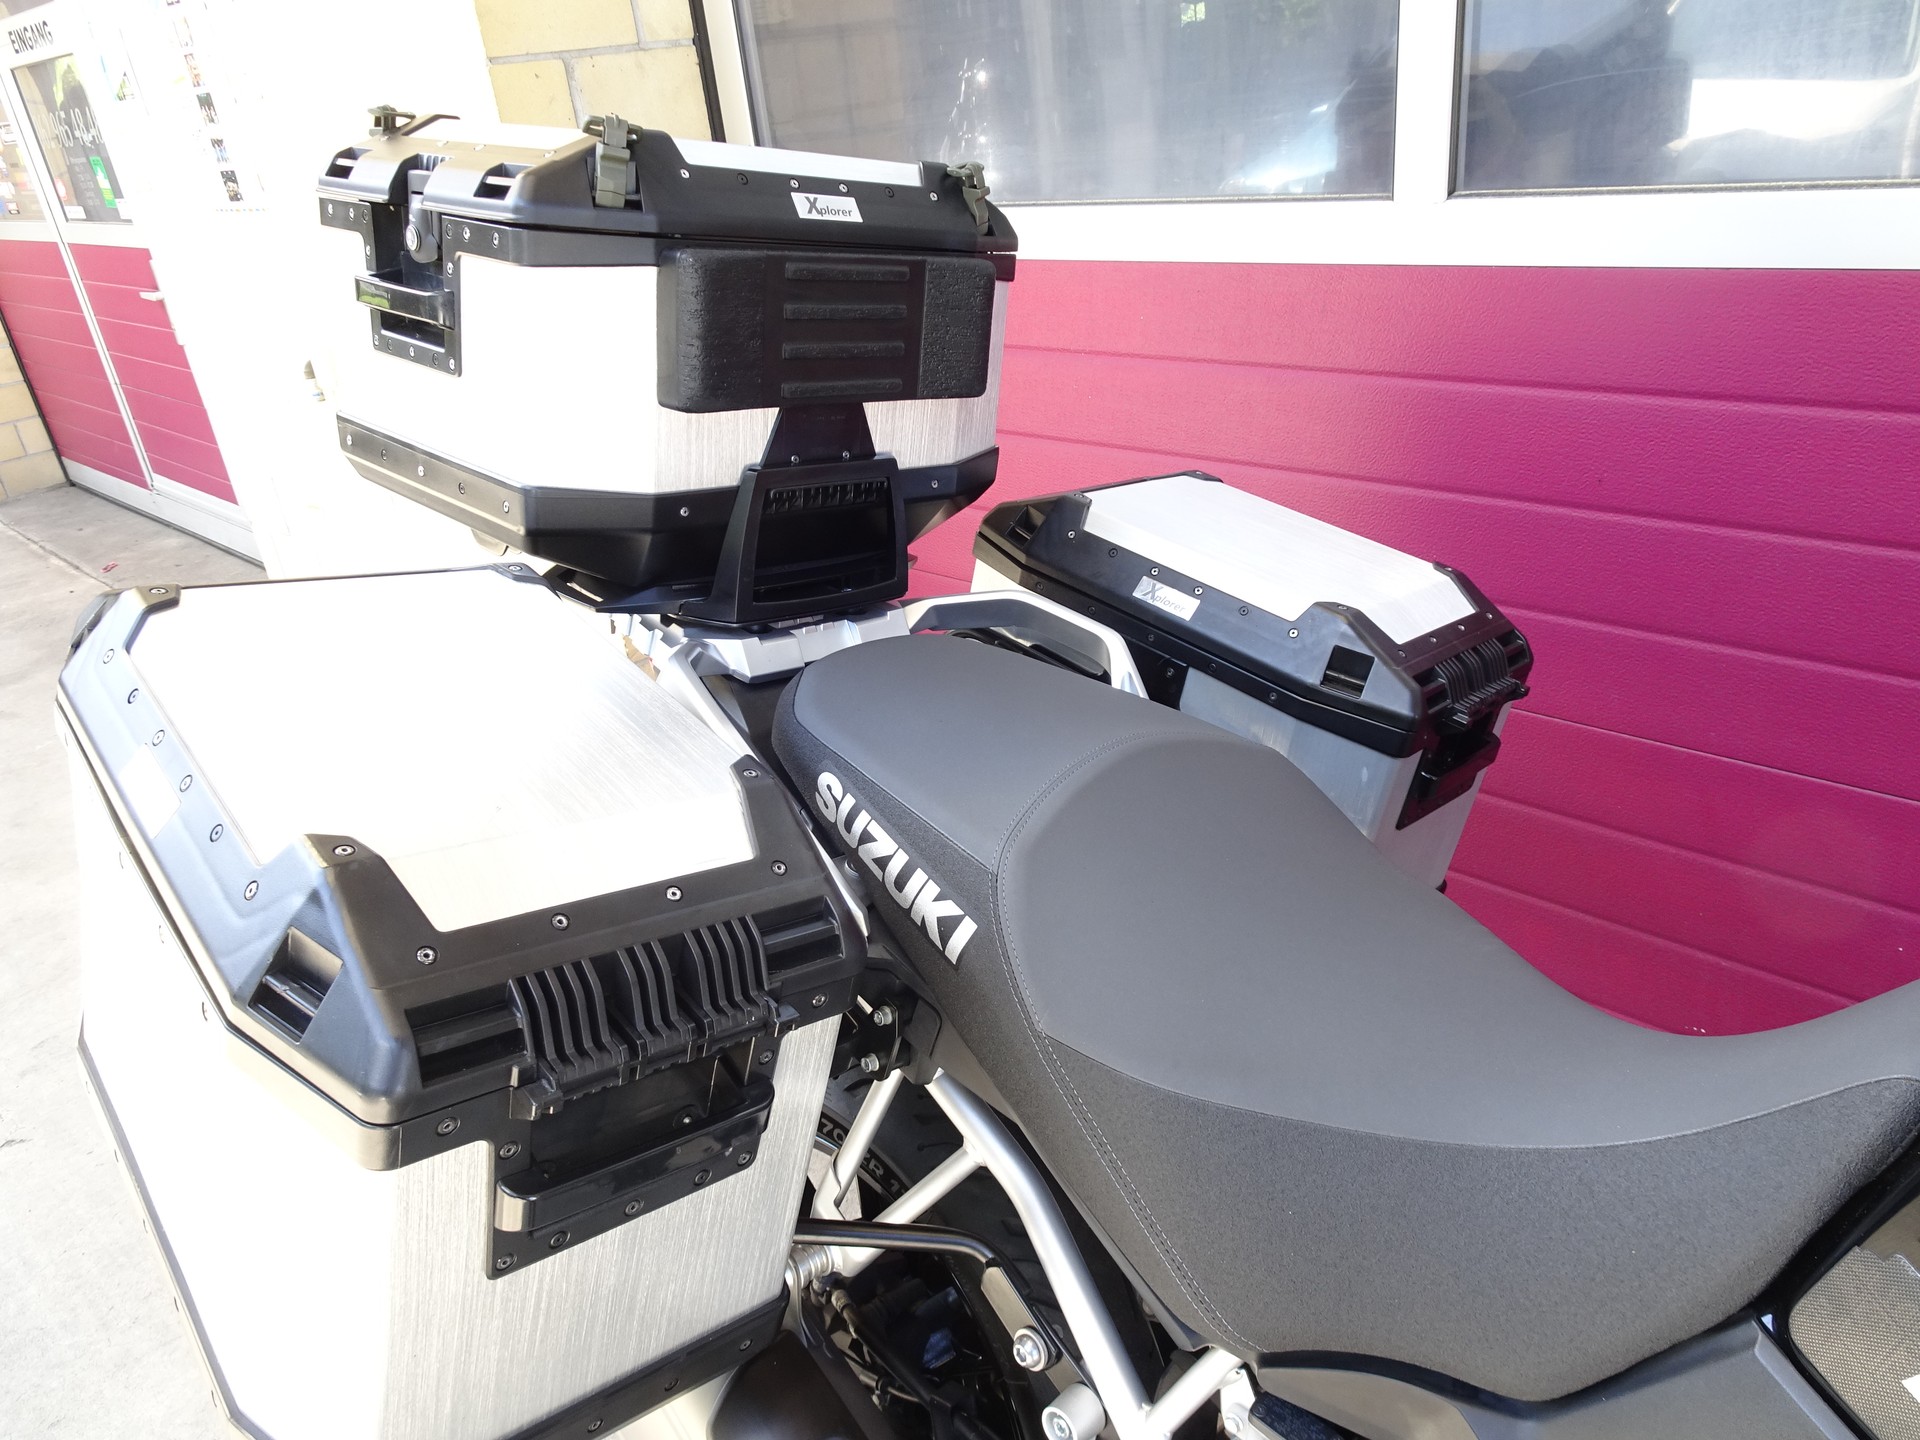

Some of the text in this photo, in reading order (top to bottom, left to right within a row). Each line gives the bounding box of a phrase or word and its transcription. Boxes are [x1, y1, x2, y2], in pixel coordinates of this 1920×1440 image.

[8, 20, 53, 54] EINGANG
[50, 111, 74, 147] 965
[804, 195, 852, 217] Xplorer
[1142, 582, 1186, 612] Xplorer
[816, 772, 978, 965] SUZUKI
